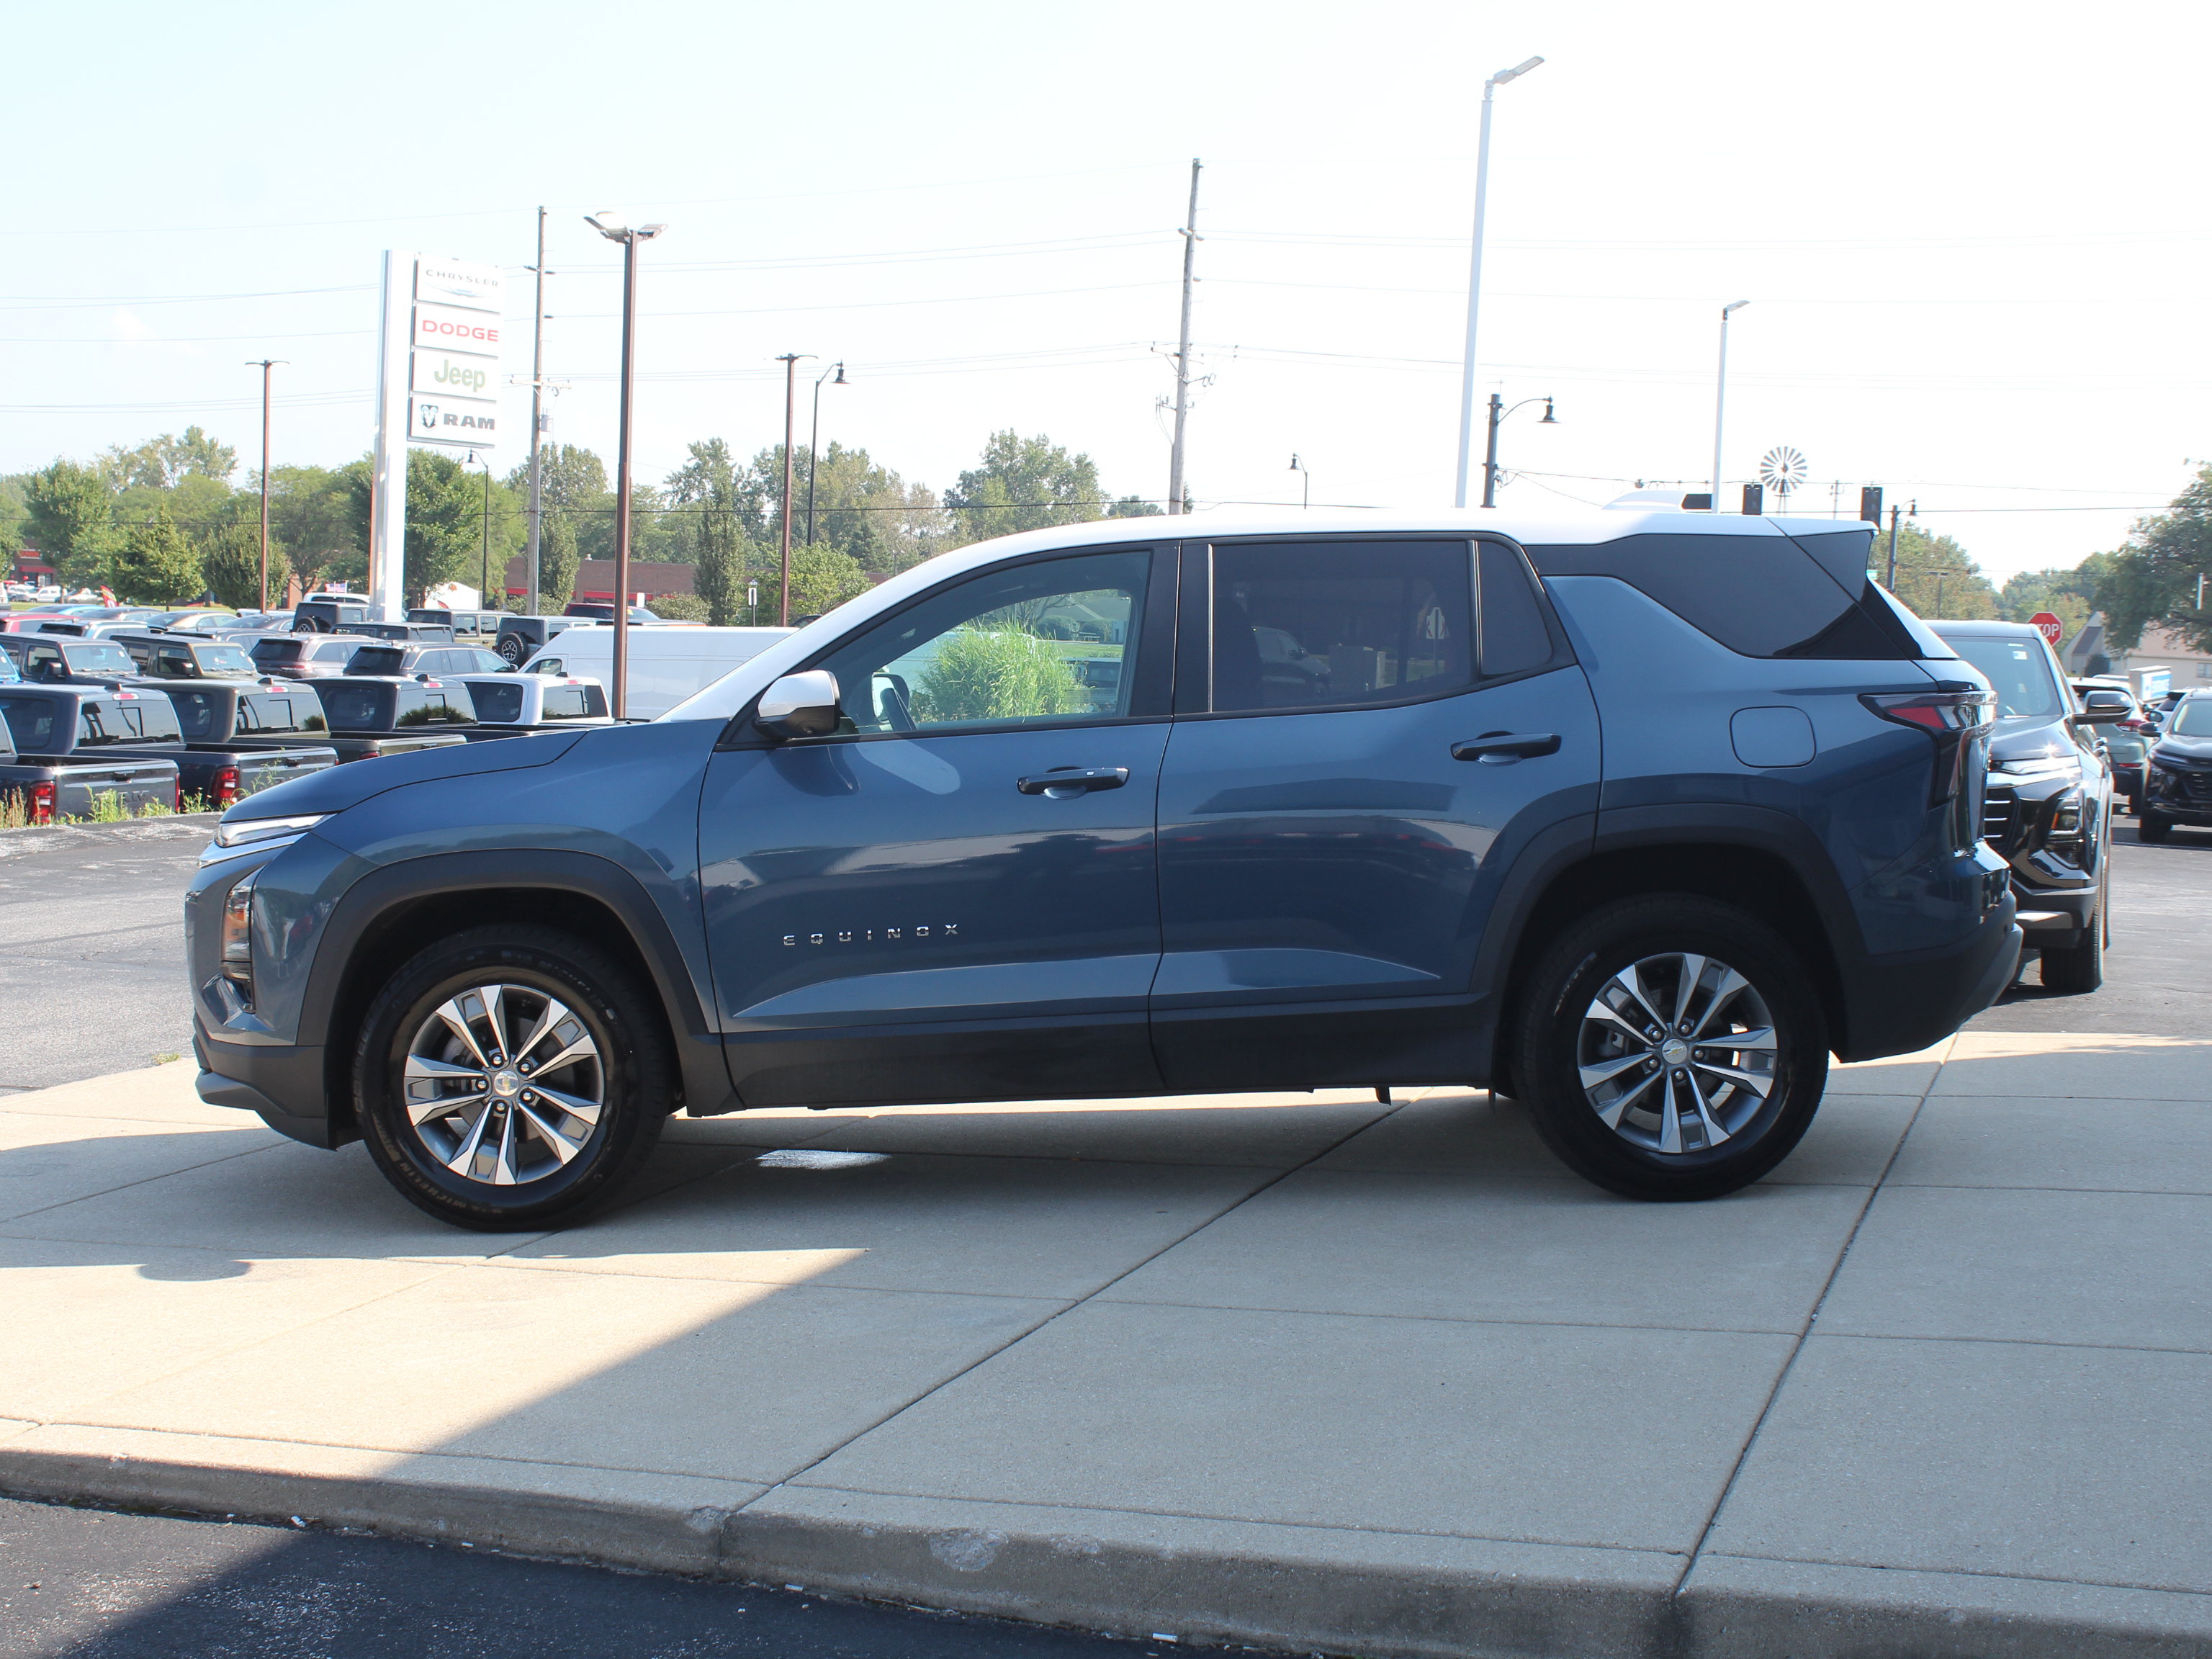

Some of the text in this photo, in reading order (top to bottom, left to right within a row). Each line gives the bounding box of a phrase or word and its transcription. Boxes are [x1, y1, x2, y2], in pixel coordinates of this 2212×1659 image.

[426, 269, 499, 287] CHRYSLER
[422, 320, 498, 342] DODGE
[434, 359, 485, 392] Jeep
[444, 413, 495, 431] RAM
[2037, 624, 2059, 637] OP
[783, 924, 958, 945] EQUINOX
